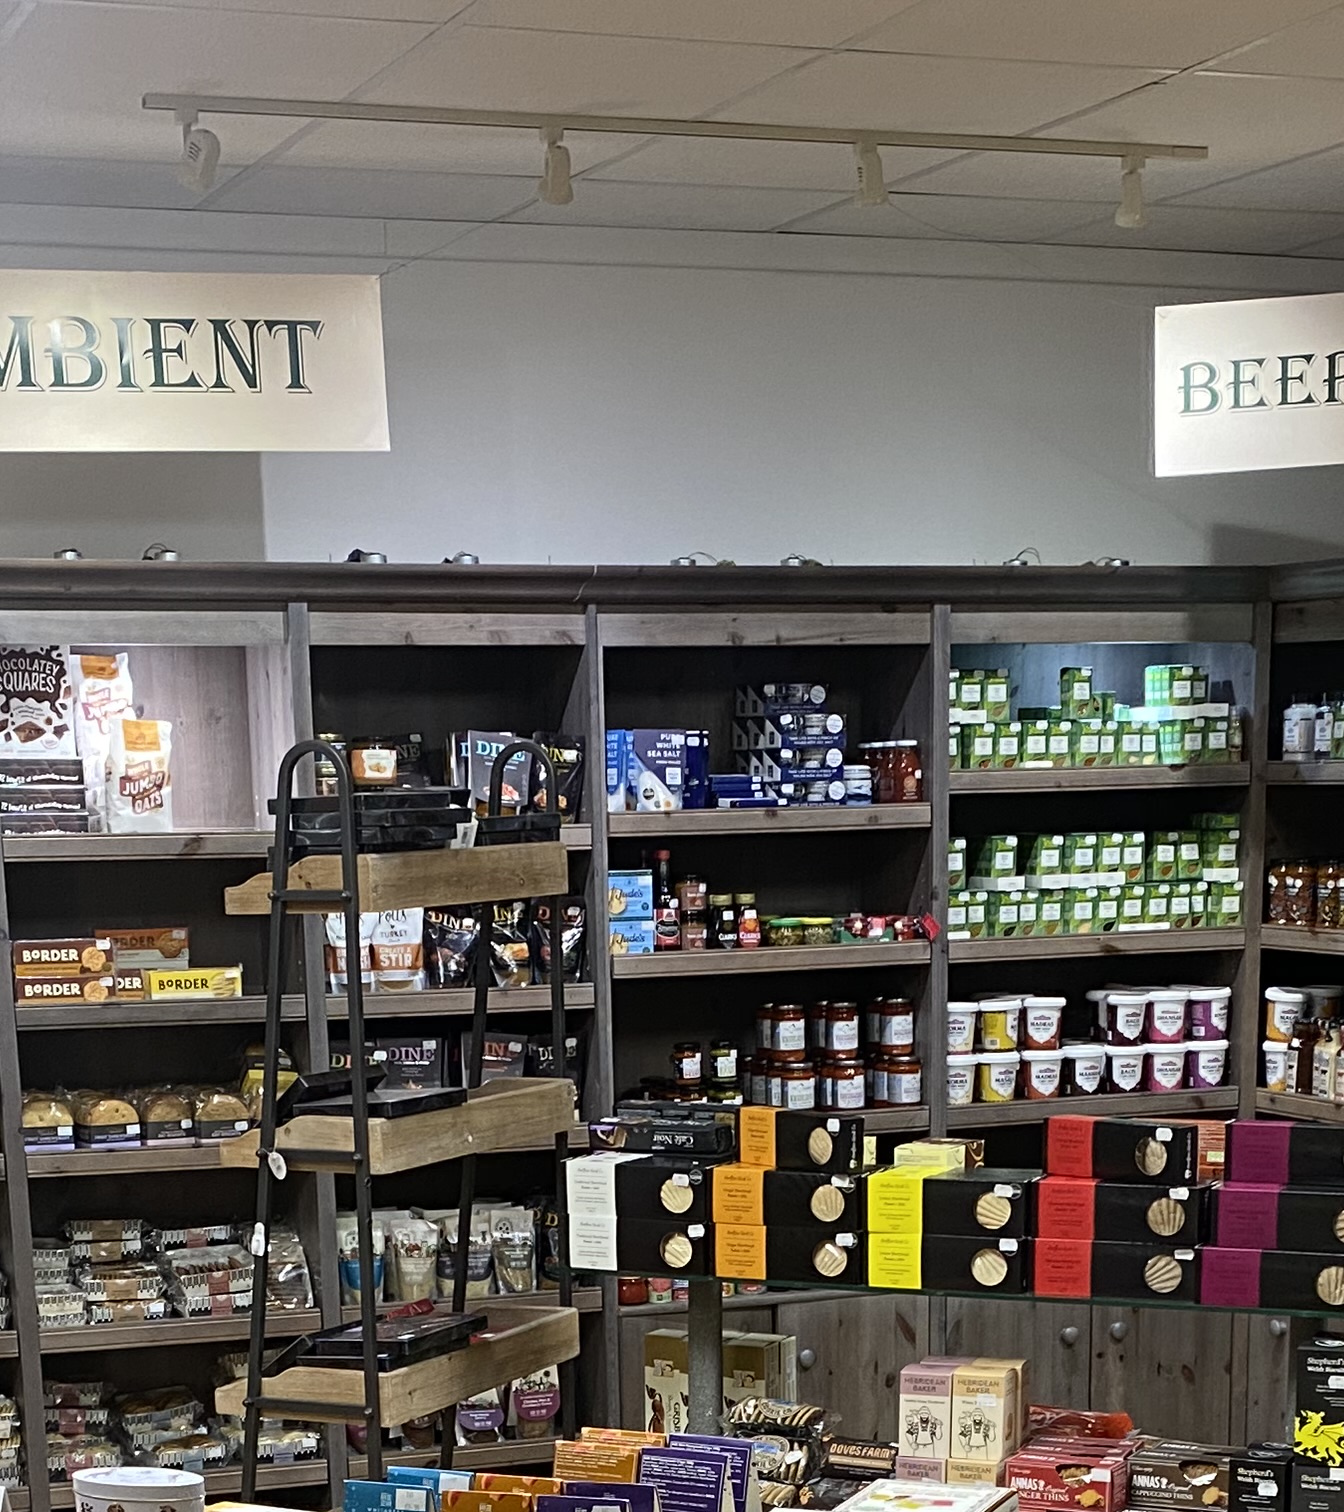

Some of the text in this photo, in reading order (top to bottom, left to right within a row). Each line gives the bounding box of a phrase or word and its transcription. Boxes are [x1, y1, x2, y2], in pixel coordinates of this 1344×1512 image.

[133, 796, 162, 814] OATS
[22, 948, 79, 962] BORDER
[380, 952, 413, 967] STIR
[24, 982, 81, 997] BORDER
[158, 978, 209, 991] BORDER
[905, 1376, 947, 1387] HEBRIDEAN
[957, 1378, 1000, 1388] HEBRIDEAN
[912, 1385, 937, 1393] BAKER
[965, 1386, 991, 1395] BAKER
[1237, 1468, 1274, 1479] Shepherd's
[1010, 1478, 1039, 1493] ANNAS
